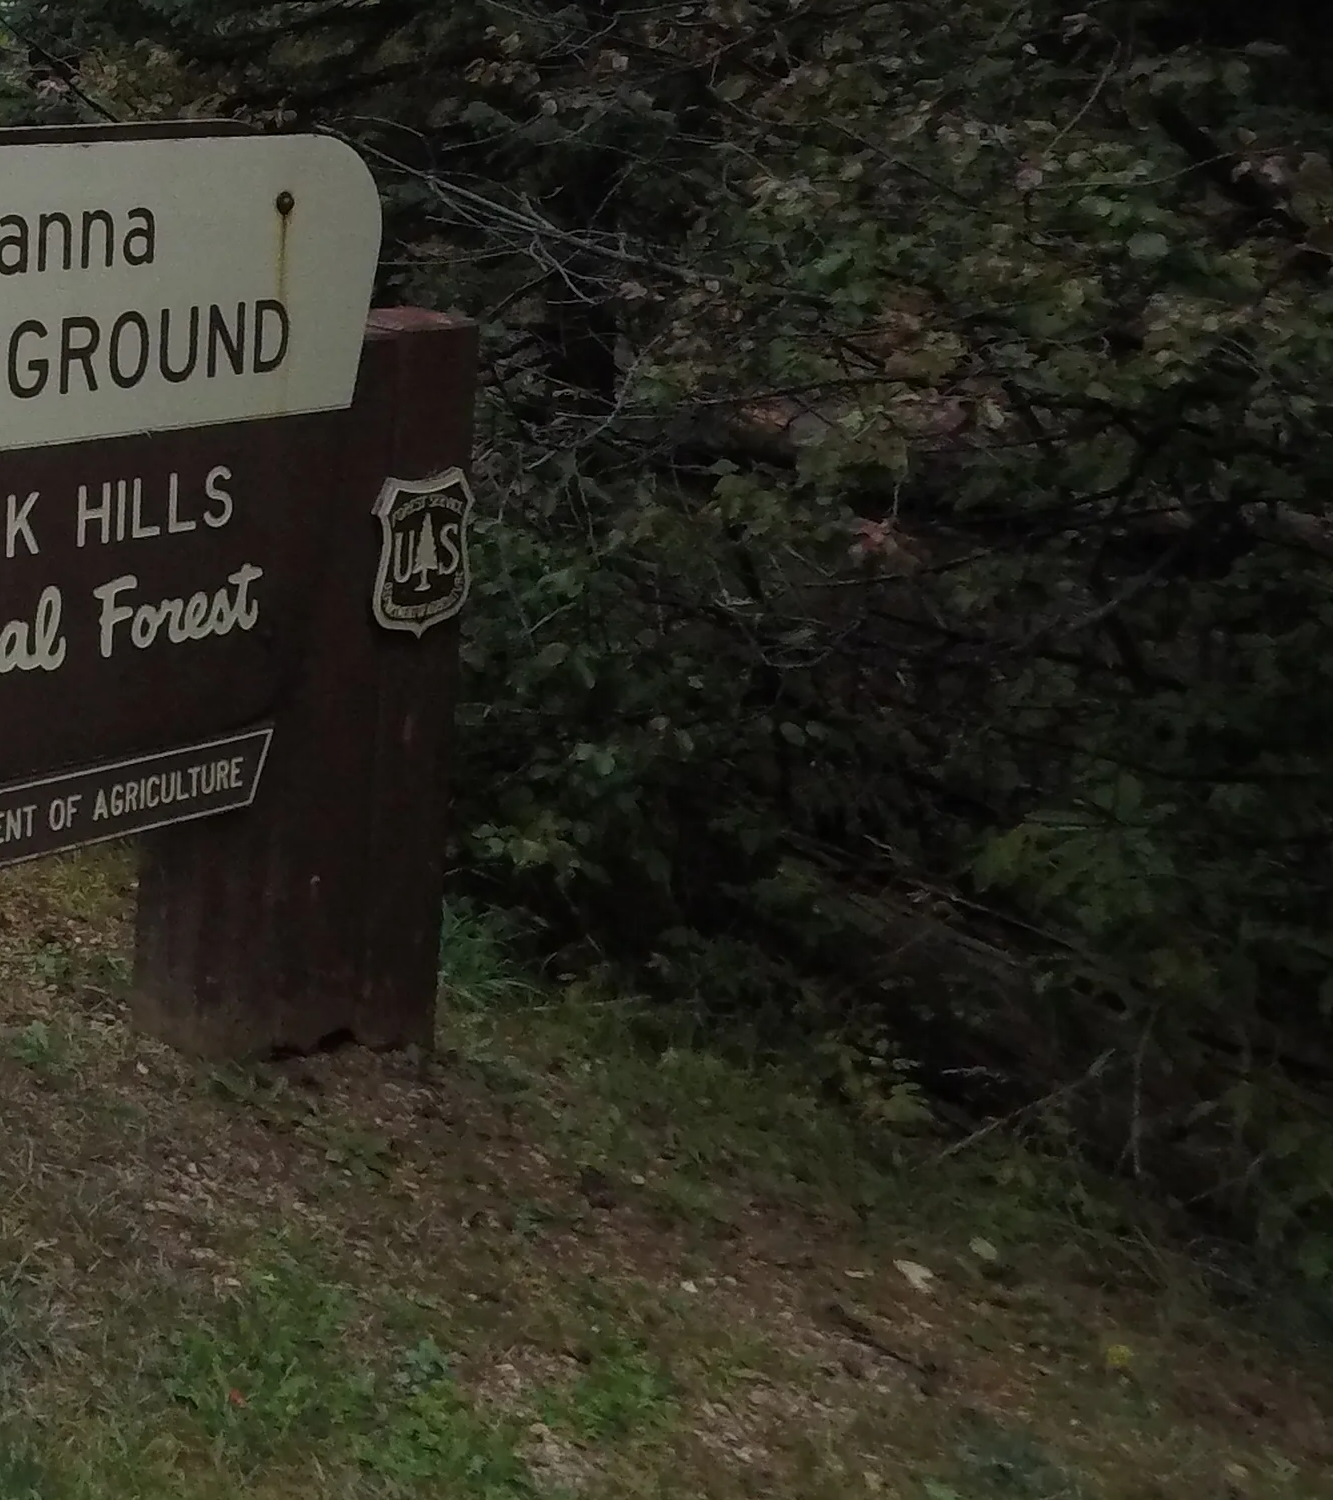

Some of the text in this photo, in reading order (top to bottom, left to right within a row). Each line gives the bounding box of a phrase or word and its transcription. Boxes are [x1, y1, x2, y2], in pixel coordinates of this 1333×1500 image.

[76, 465, 233, 548] HILLS
[93, 562, 264, 658] Forest
[48, 794, 82, 831] OF
[92, 756, 245, 821] AGRICULTURE
